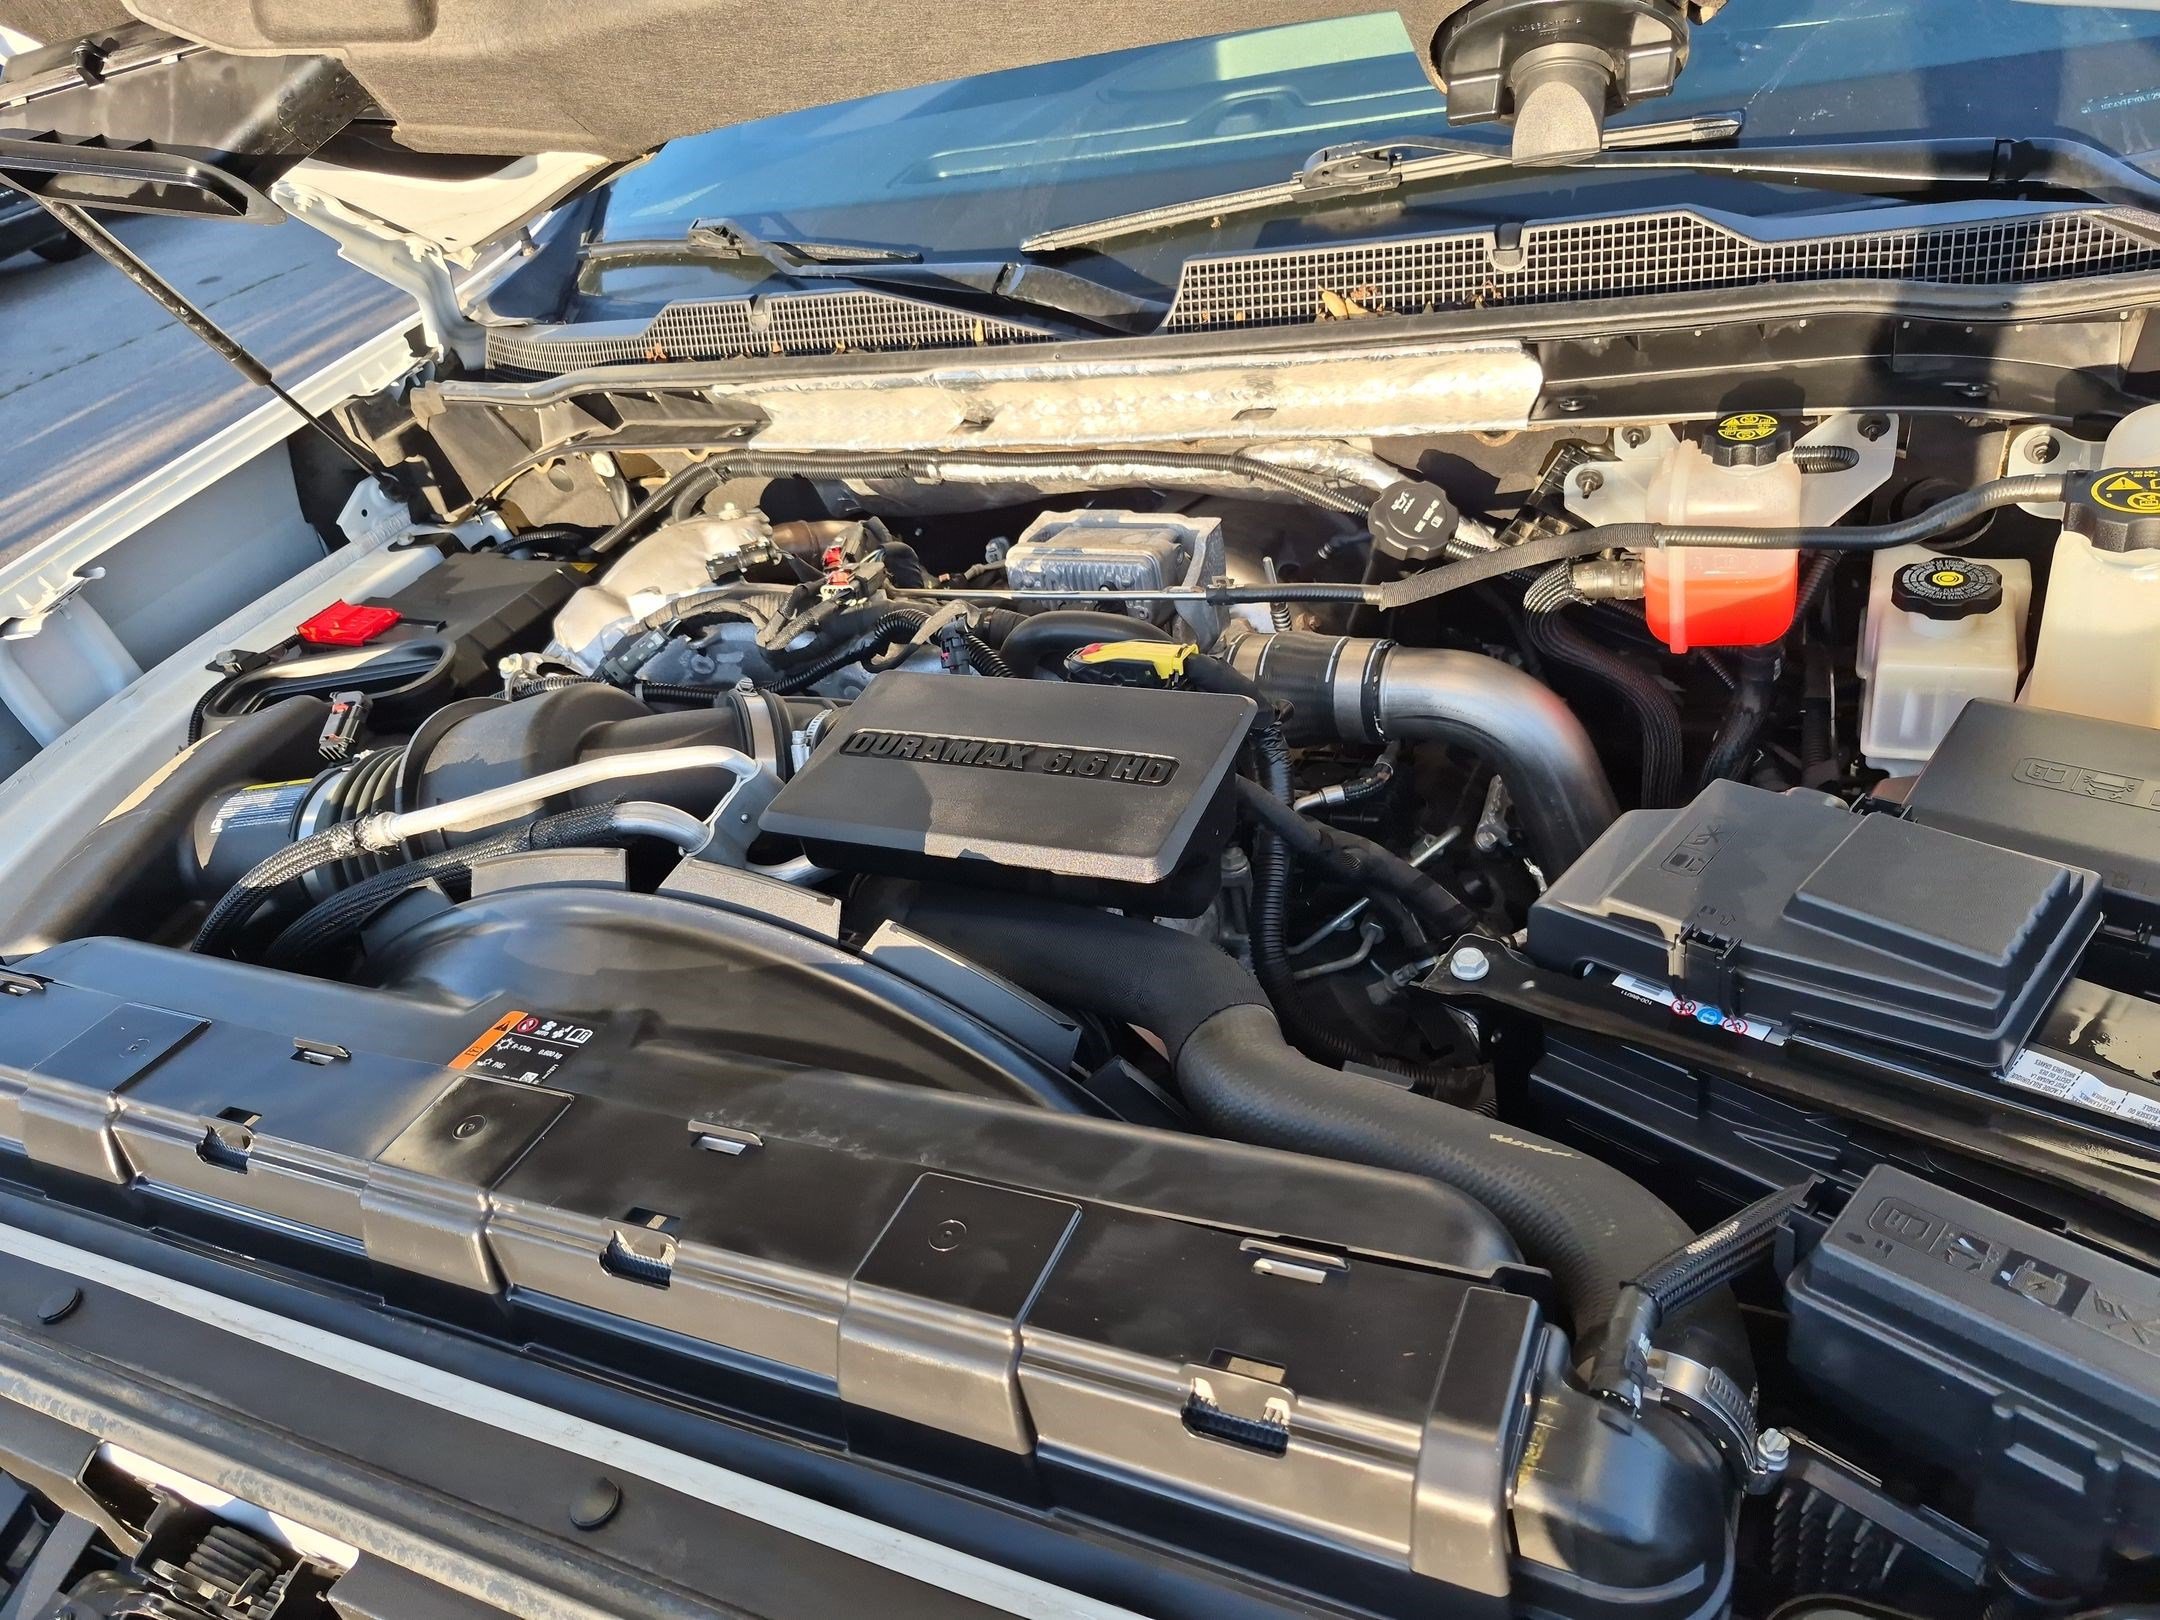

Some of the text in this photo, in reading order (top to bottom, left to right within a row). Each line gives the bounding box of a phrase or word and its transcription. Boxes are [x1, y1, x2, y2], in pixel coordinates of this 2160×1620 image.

[849, 732, 1176, 784] DURAMAX 6.6 HD
[2035, 1059, 2052, 1069] GRAVES
[2011, 1073, 2042, 1089] SULFURIQUE
